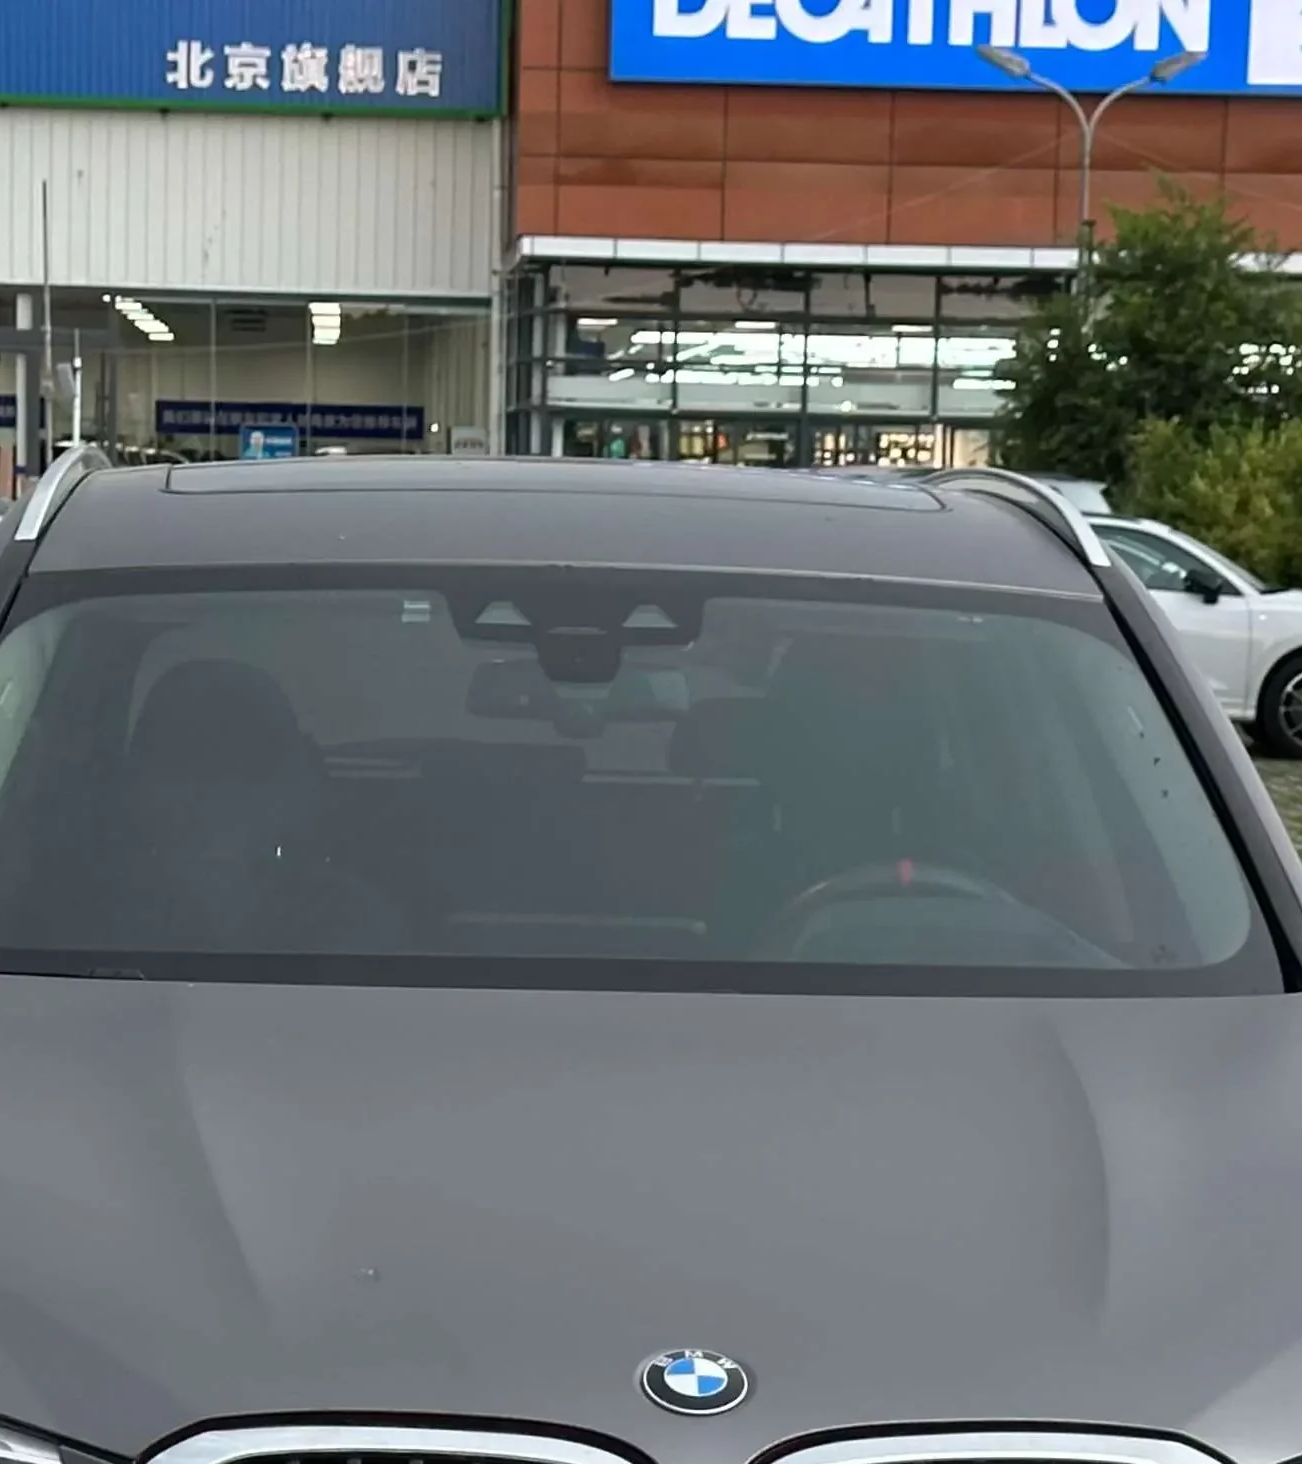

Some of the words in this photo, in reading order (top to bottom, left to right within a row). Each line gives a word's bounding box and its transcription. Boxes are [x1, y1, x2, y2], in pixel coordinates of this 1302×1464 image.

[165, 40, 443, 97] 北京旗舰店
[652, 1350, 741, 1369] BMW
